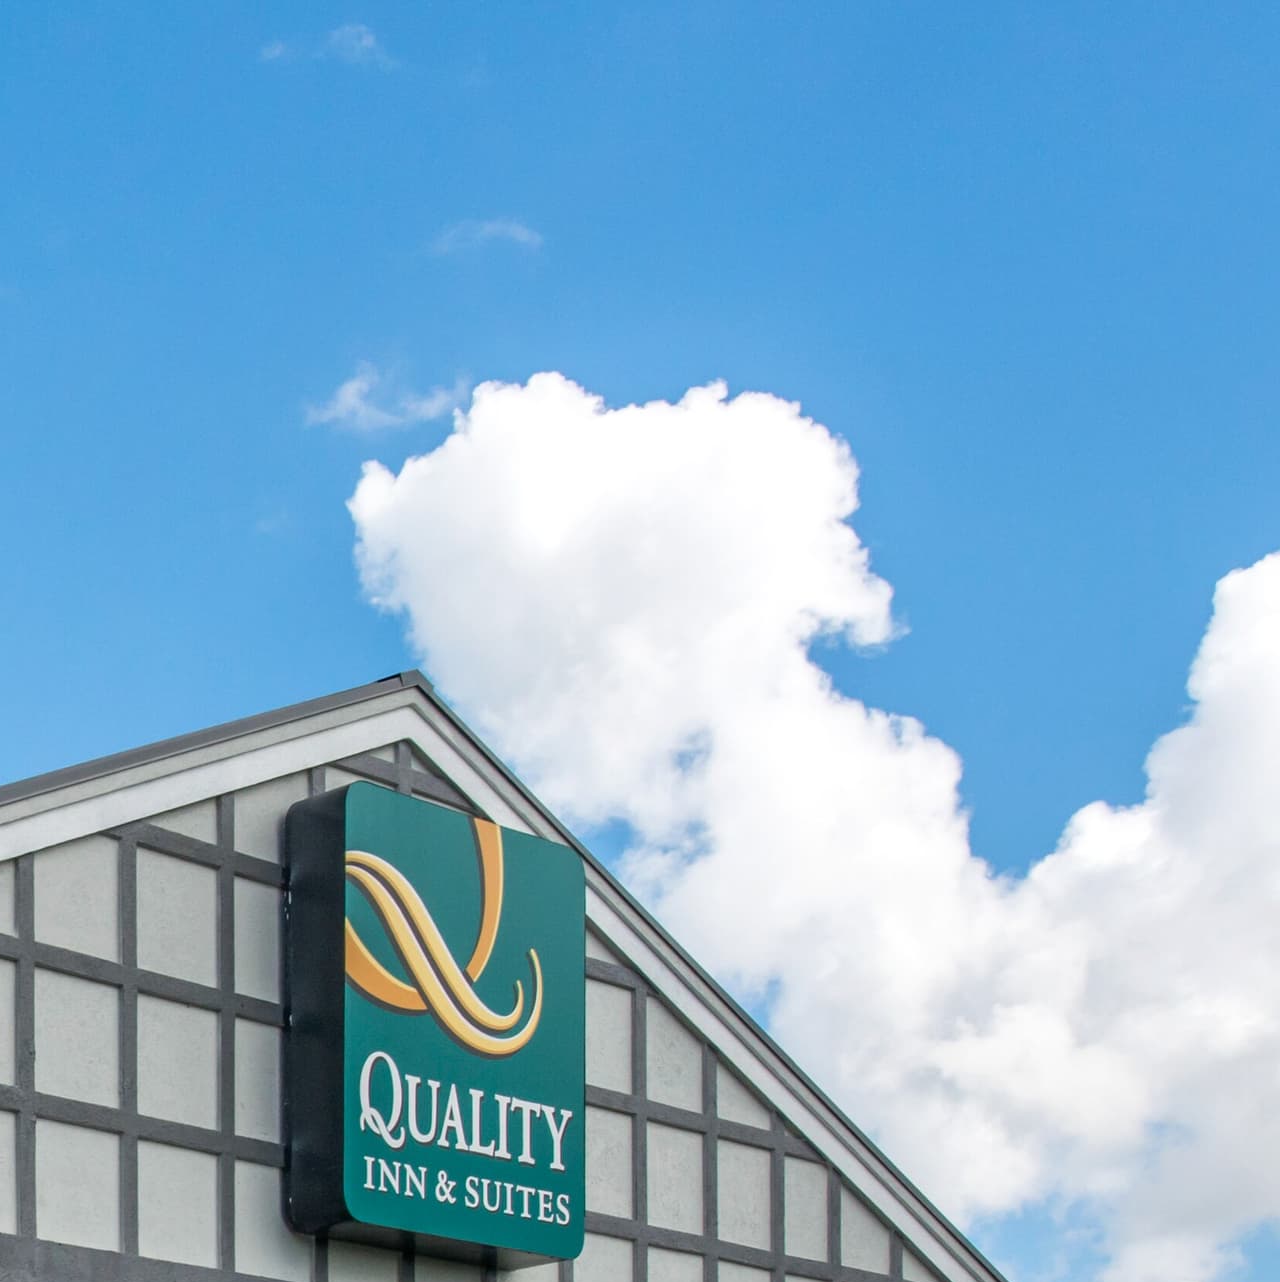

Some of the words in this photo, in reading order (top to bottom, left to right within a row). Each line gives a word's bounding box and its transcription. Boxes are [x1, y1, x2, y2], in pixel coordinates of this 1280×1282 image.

[359, 1051, 573, 1171] QUALITY
[363, 1155, 428, 1200] INN
[435, 1170, 457, 1204] &
[464, 1176, 571, 1226] SUITES
